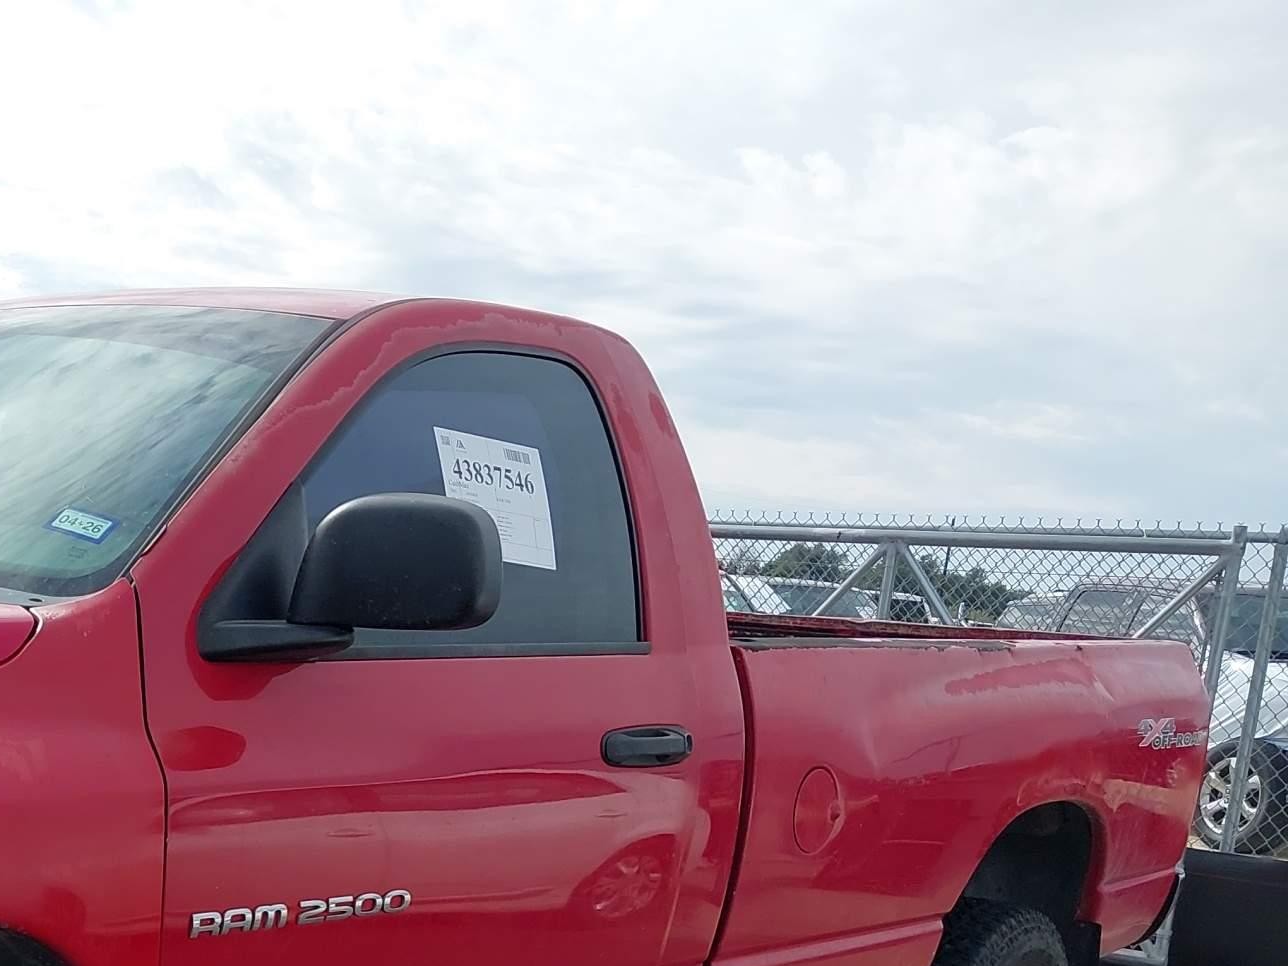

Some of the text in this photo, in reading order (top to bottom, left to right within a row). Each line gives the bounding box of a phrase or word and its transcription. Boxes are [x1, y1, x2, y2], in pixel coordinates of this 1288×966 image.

[453, 458, 535, 495] 43837546
[189, 889, 412, 939] RAM 2500
